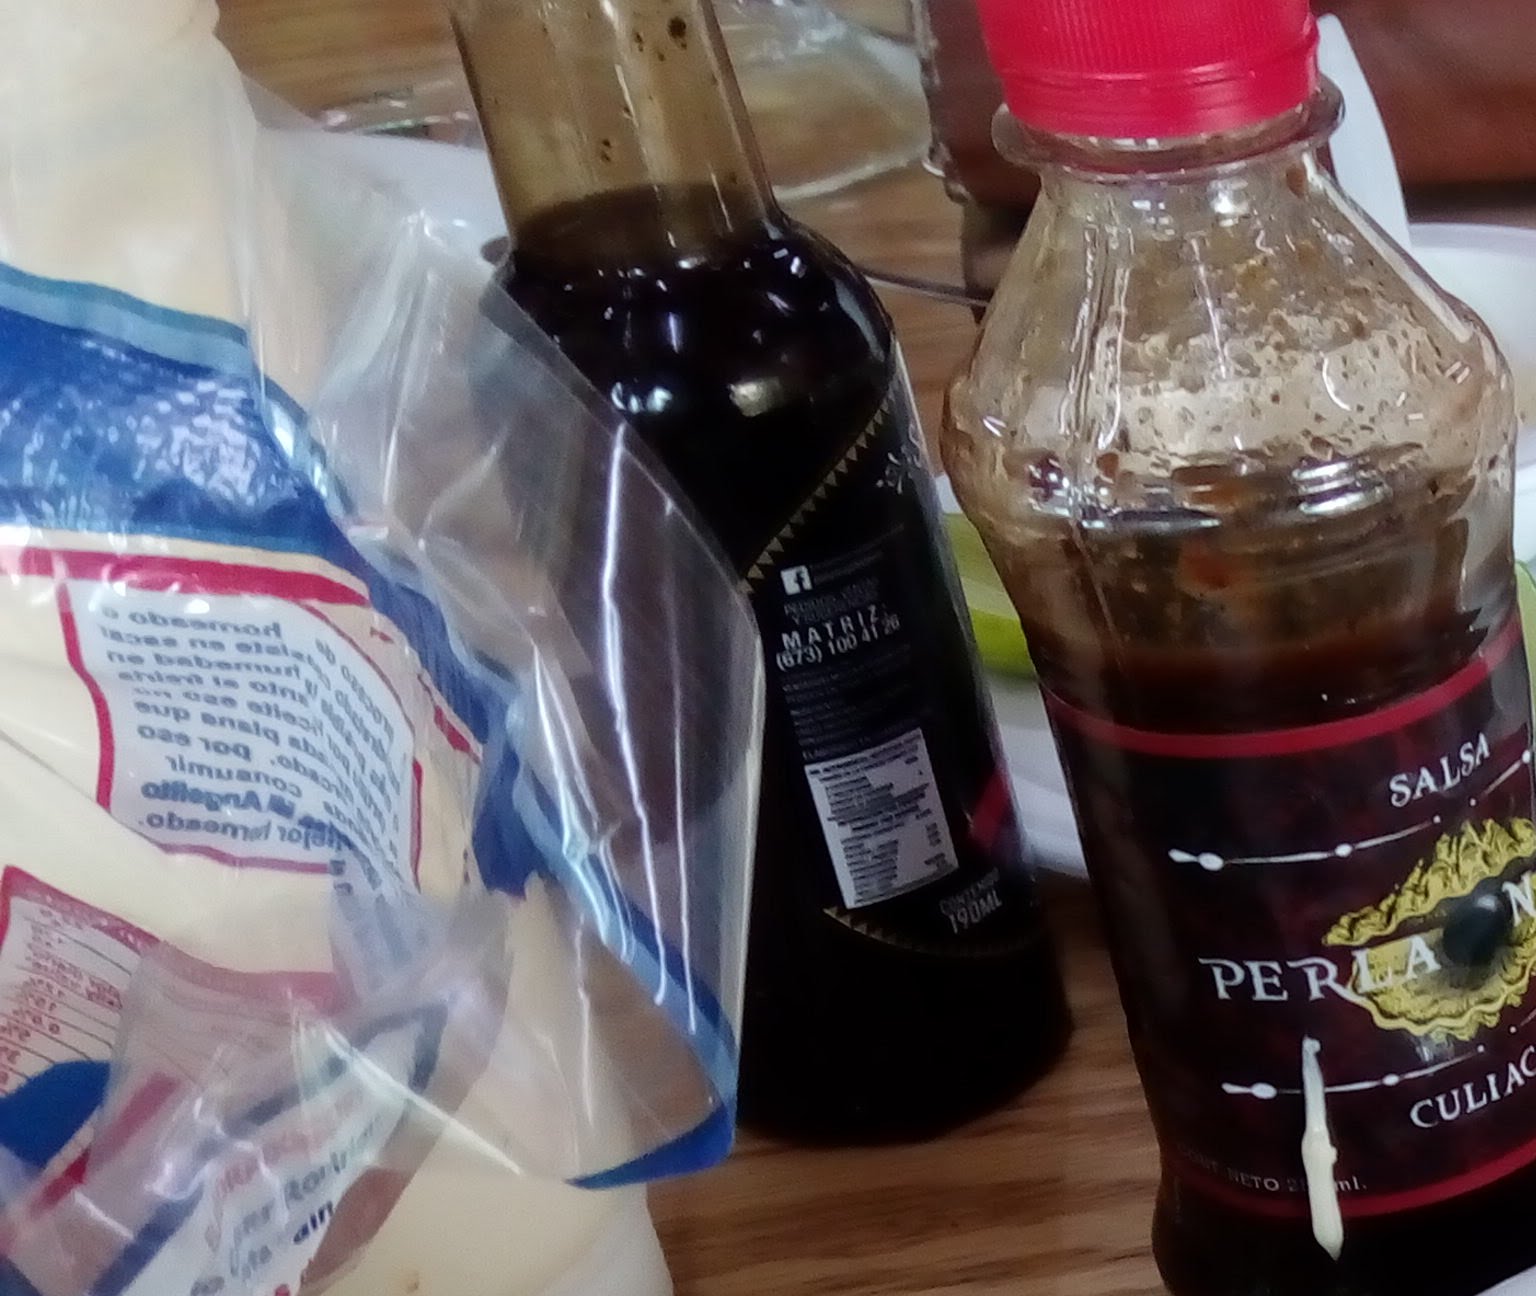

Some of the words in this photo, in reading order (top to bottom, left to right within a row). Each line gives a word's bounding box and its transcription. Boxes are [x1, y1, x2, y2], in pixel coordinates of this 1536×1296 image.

[827, 633, 858, 655] 100
[1389, 732, 1490, 807] SALSA
[1198, 934, 1442, 1004] PERLA
